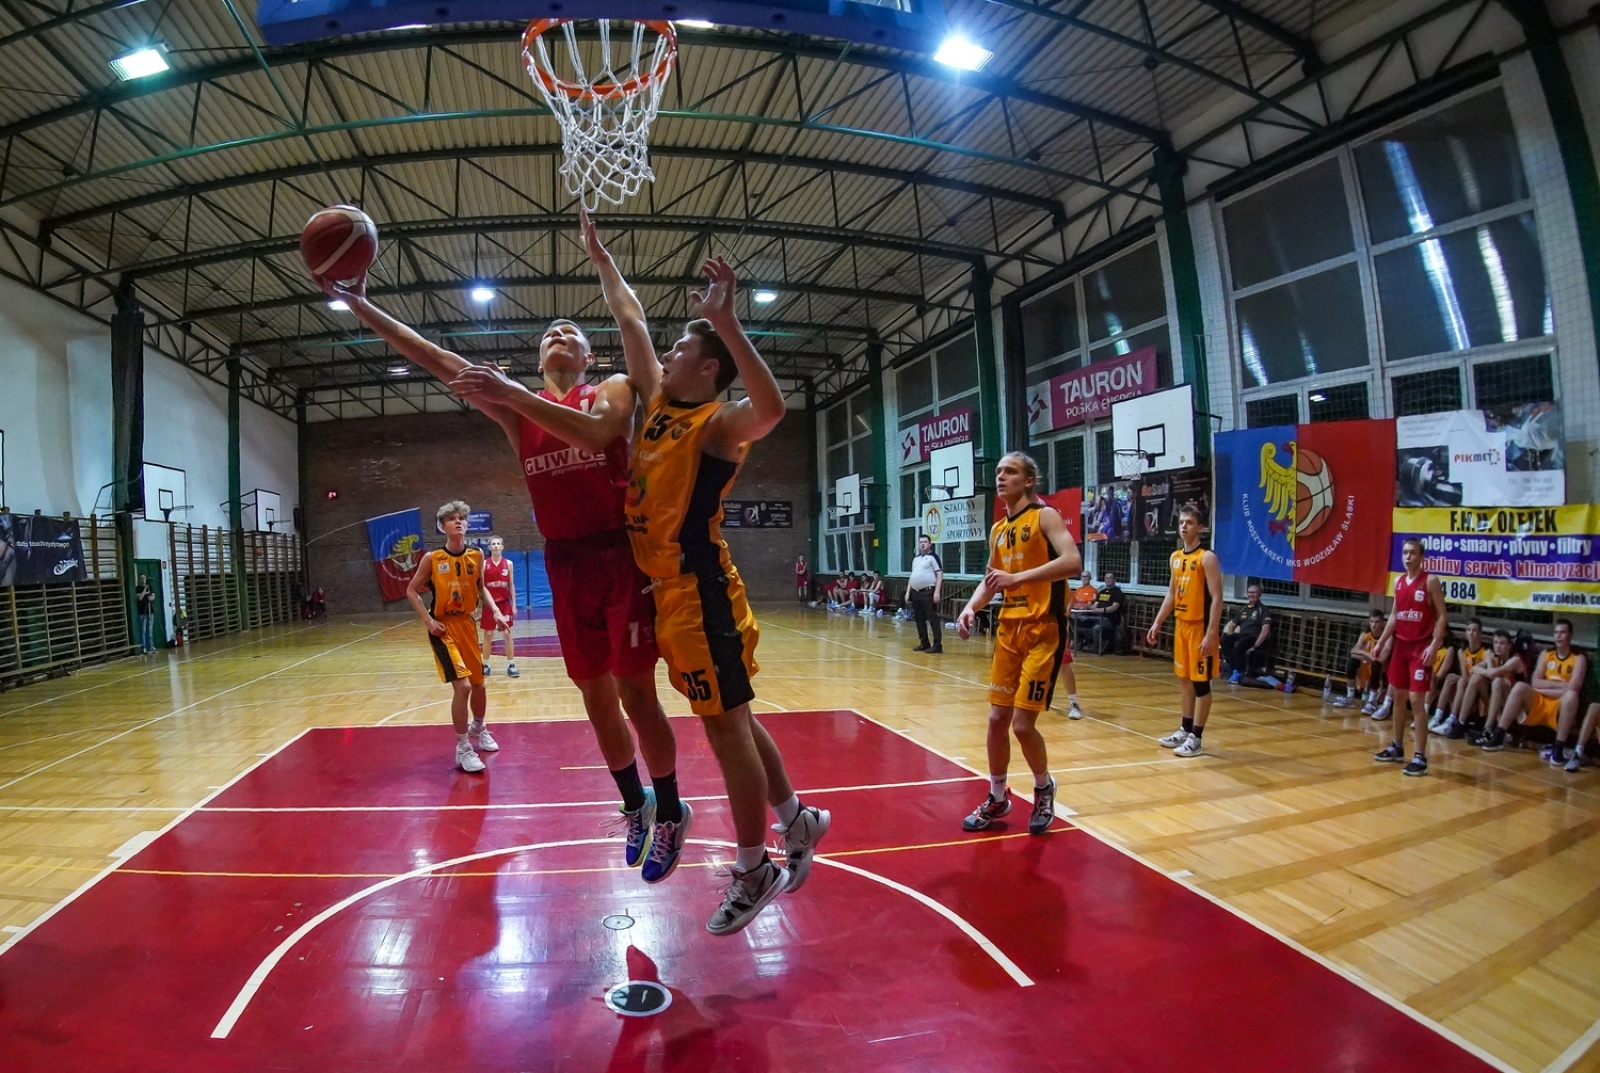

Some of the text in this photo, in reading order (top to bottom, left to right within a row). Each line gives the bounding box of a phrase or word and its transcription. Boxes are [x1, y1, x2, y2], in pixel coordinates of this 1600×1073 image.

[1060, 360, 1143, 404] TAURON
[921, 412, 969, 444] TAURON
[1453, 452, 1494, 463] PIKMET
[944, 501, 975, 513] SZKOLNY
[946, 514, 977, 527] ZWIĄZEK
[946, 528, 982, 540] SPORTOWY
[1006, 526, 1016, 549] 15
[1242, 493, 1250, 517] KLUB
[1247, 520, 1284, 564] KOSZYKARSKI
[1286, 558, 1301, 567] MKS
[1303, 532, 1343, 567] WODZISŁAW
[1421, 535, 1453, 552] oleje
[1460, 538, 1502, 555] smary
[1557, 537, 1591, 556] filtry
[501, 568, 509, 577] 3
[1420, 556, 1461, 575] obilny
[1464, 560, 1512, 576] serwis
[1414, 589, 1425, 602] 6
[1451, 582, 1477, 600] 884
[1197, 660, 1205, 675] 5
[1413, 668, 1425, 681] 6
[681, 669, 712, 702] 35
[1027, 679, 1046, 702] 15
